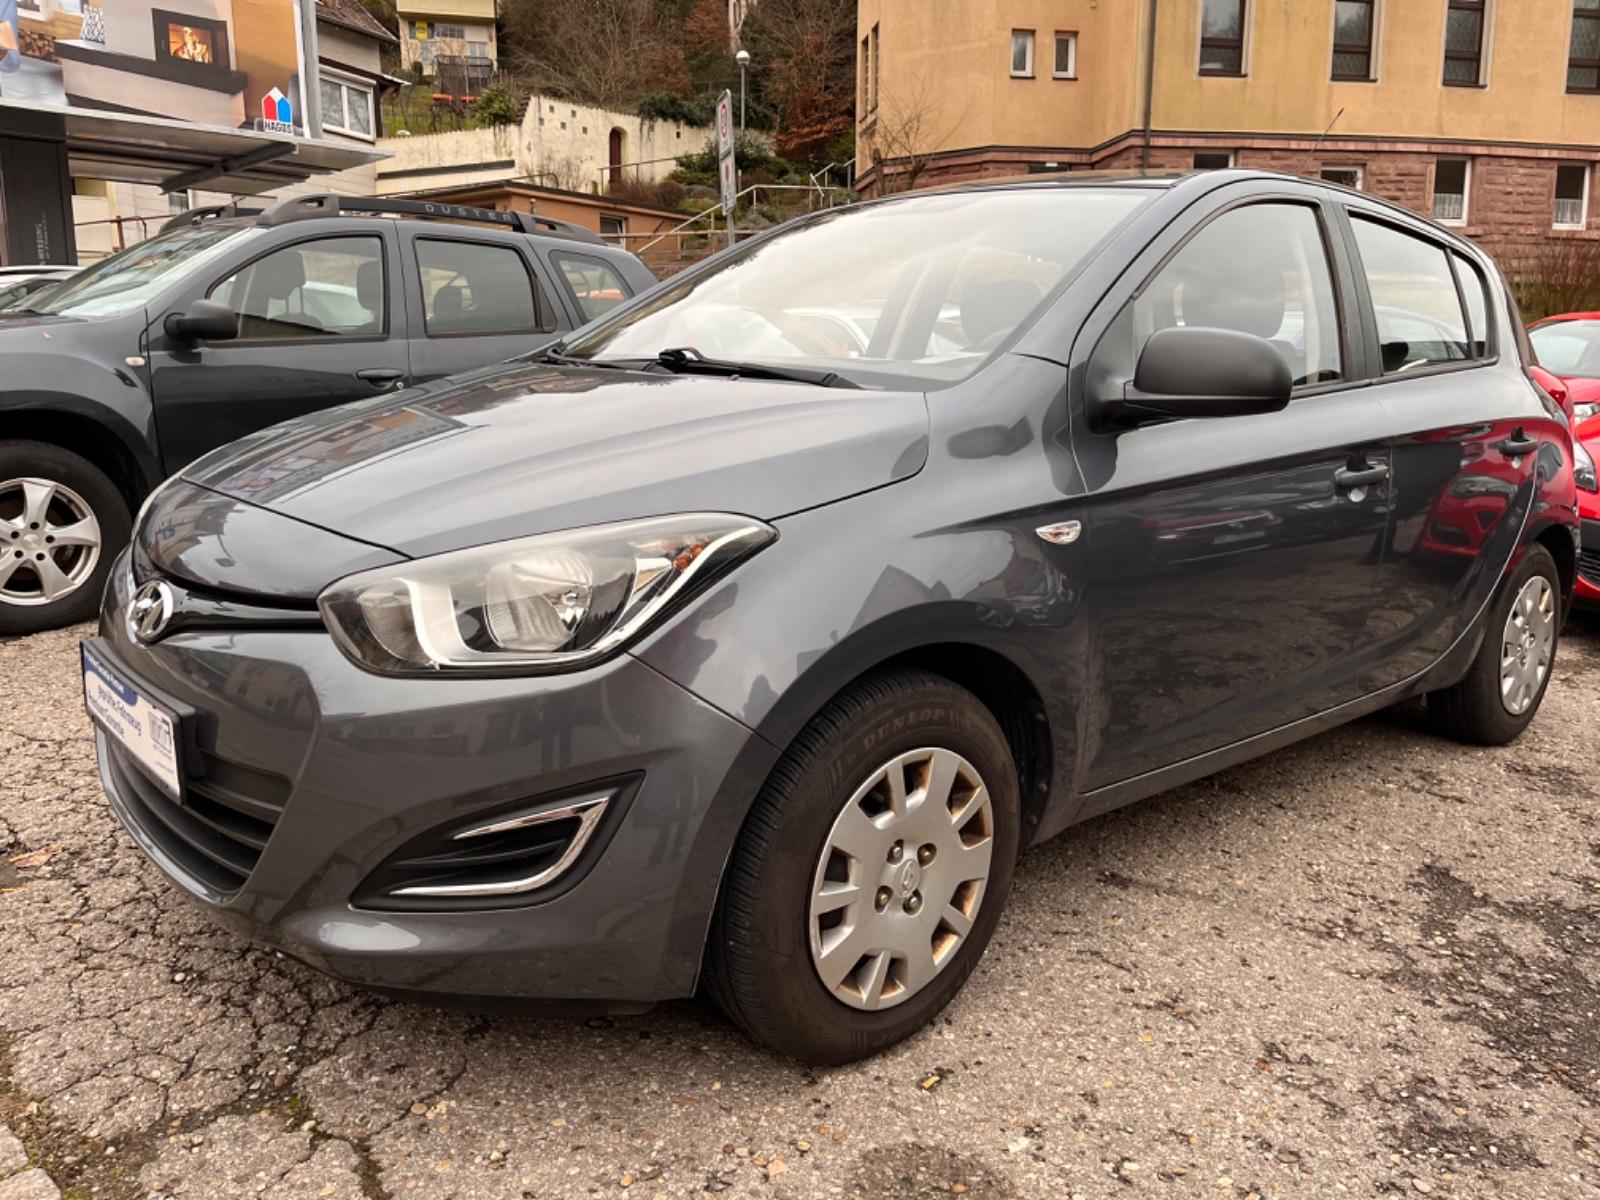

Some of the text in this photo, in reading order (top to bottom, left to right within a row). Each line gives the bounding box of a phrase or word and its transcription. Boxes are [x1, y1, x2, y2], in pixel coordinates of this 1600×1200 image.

[264, 120, 293, 133] HAGOS
[424, 204, 511, 221] DUSTER
[863, 708, 945, 751] DUNLOP
